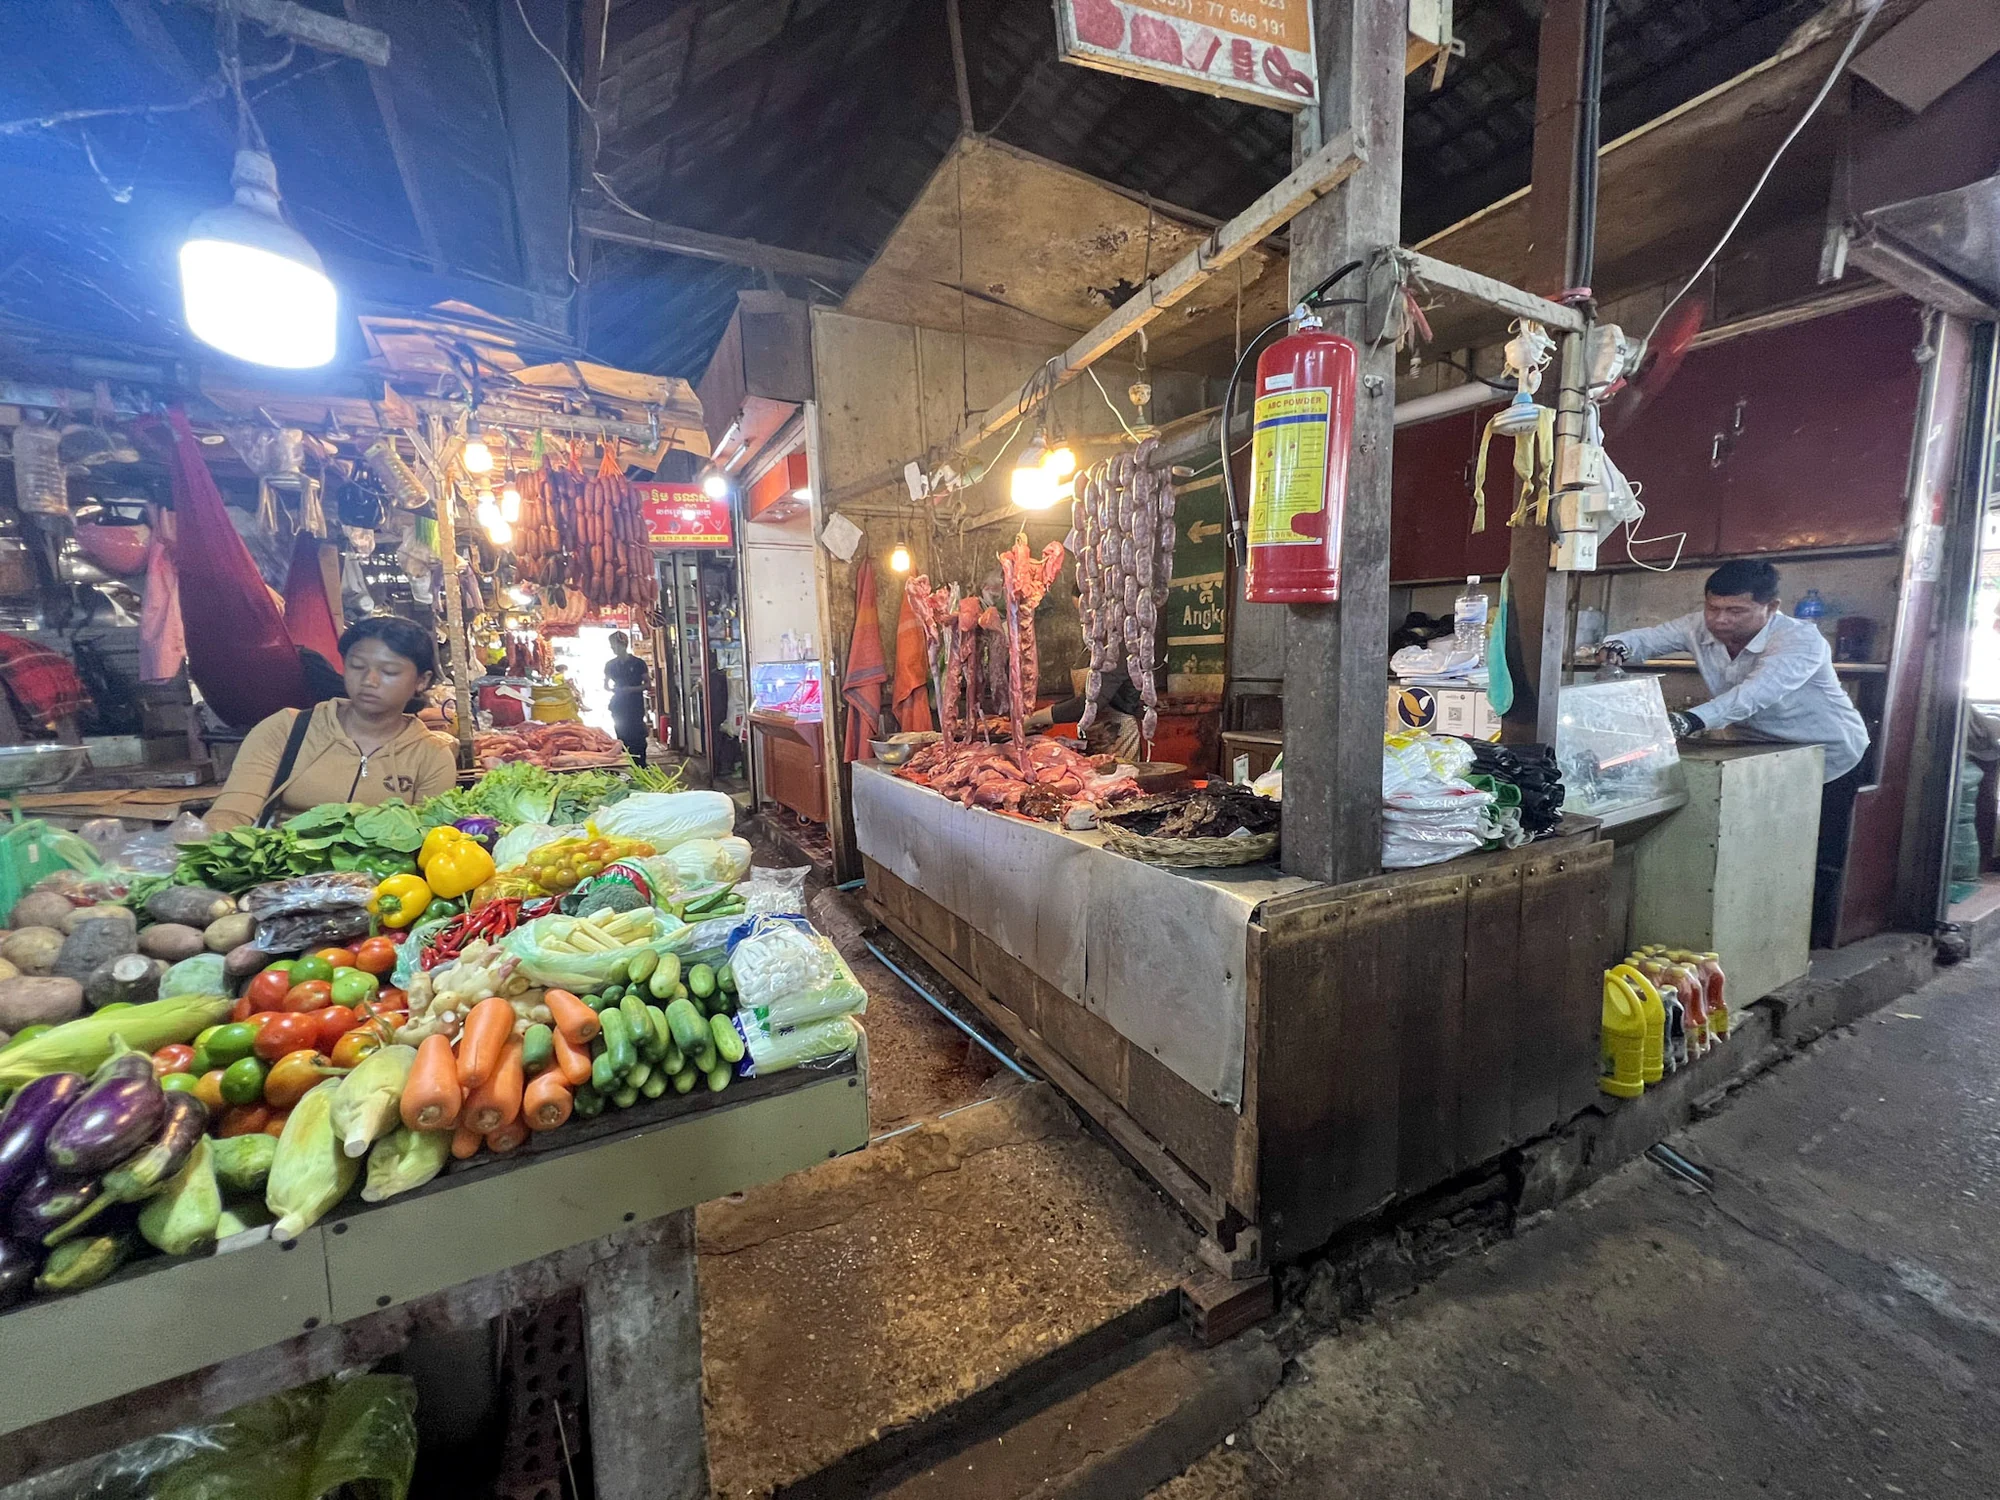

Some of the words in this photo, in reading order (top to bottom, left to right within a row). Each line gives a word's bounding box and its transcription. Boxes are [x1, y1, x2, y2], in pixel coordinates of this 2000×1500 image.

[1206, 2, 1225, 19] 77
[1229, 8, 1258, 29] 646
[1261, 18, 1286, 38] 191
[1267, 401, 1282, 410] ABC
[1283, 396, 1322, 407] POWDER
